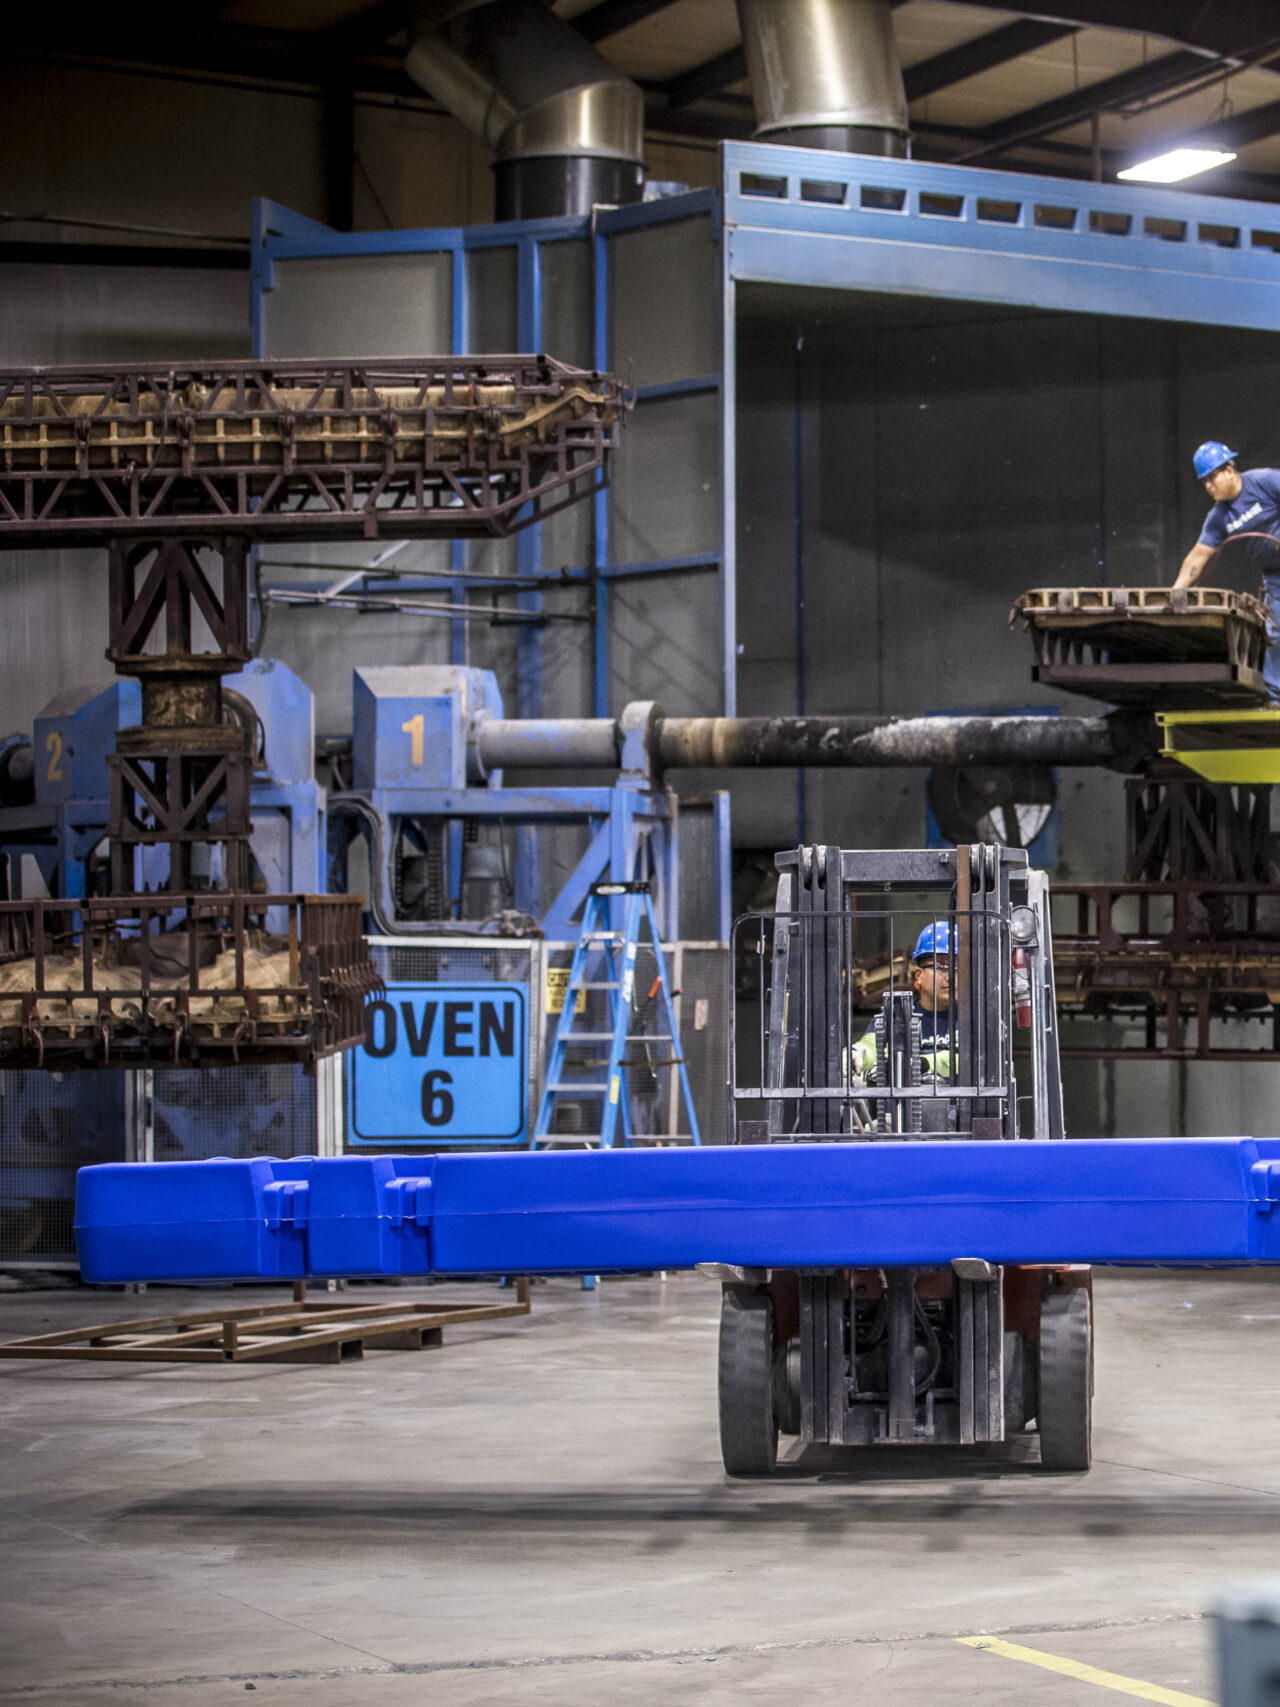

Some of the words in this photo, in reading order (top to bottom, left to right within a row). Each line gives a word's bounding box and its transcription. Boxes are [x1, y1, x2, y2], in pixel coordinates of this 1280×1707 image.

[46, 732, 63, 781] 2
[402, 714, 424, 766] 1
[363, 1001, 514, 1058] OVEN
[421, 1070, 454, 1127] 6
